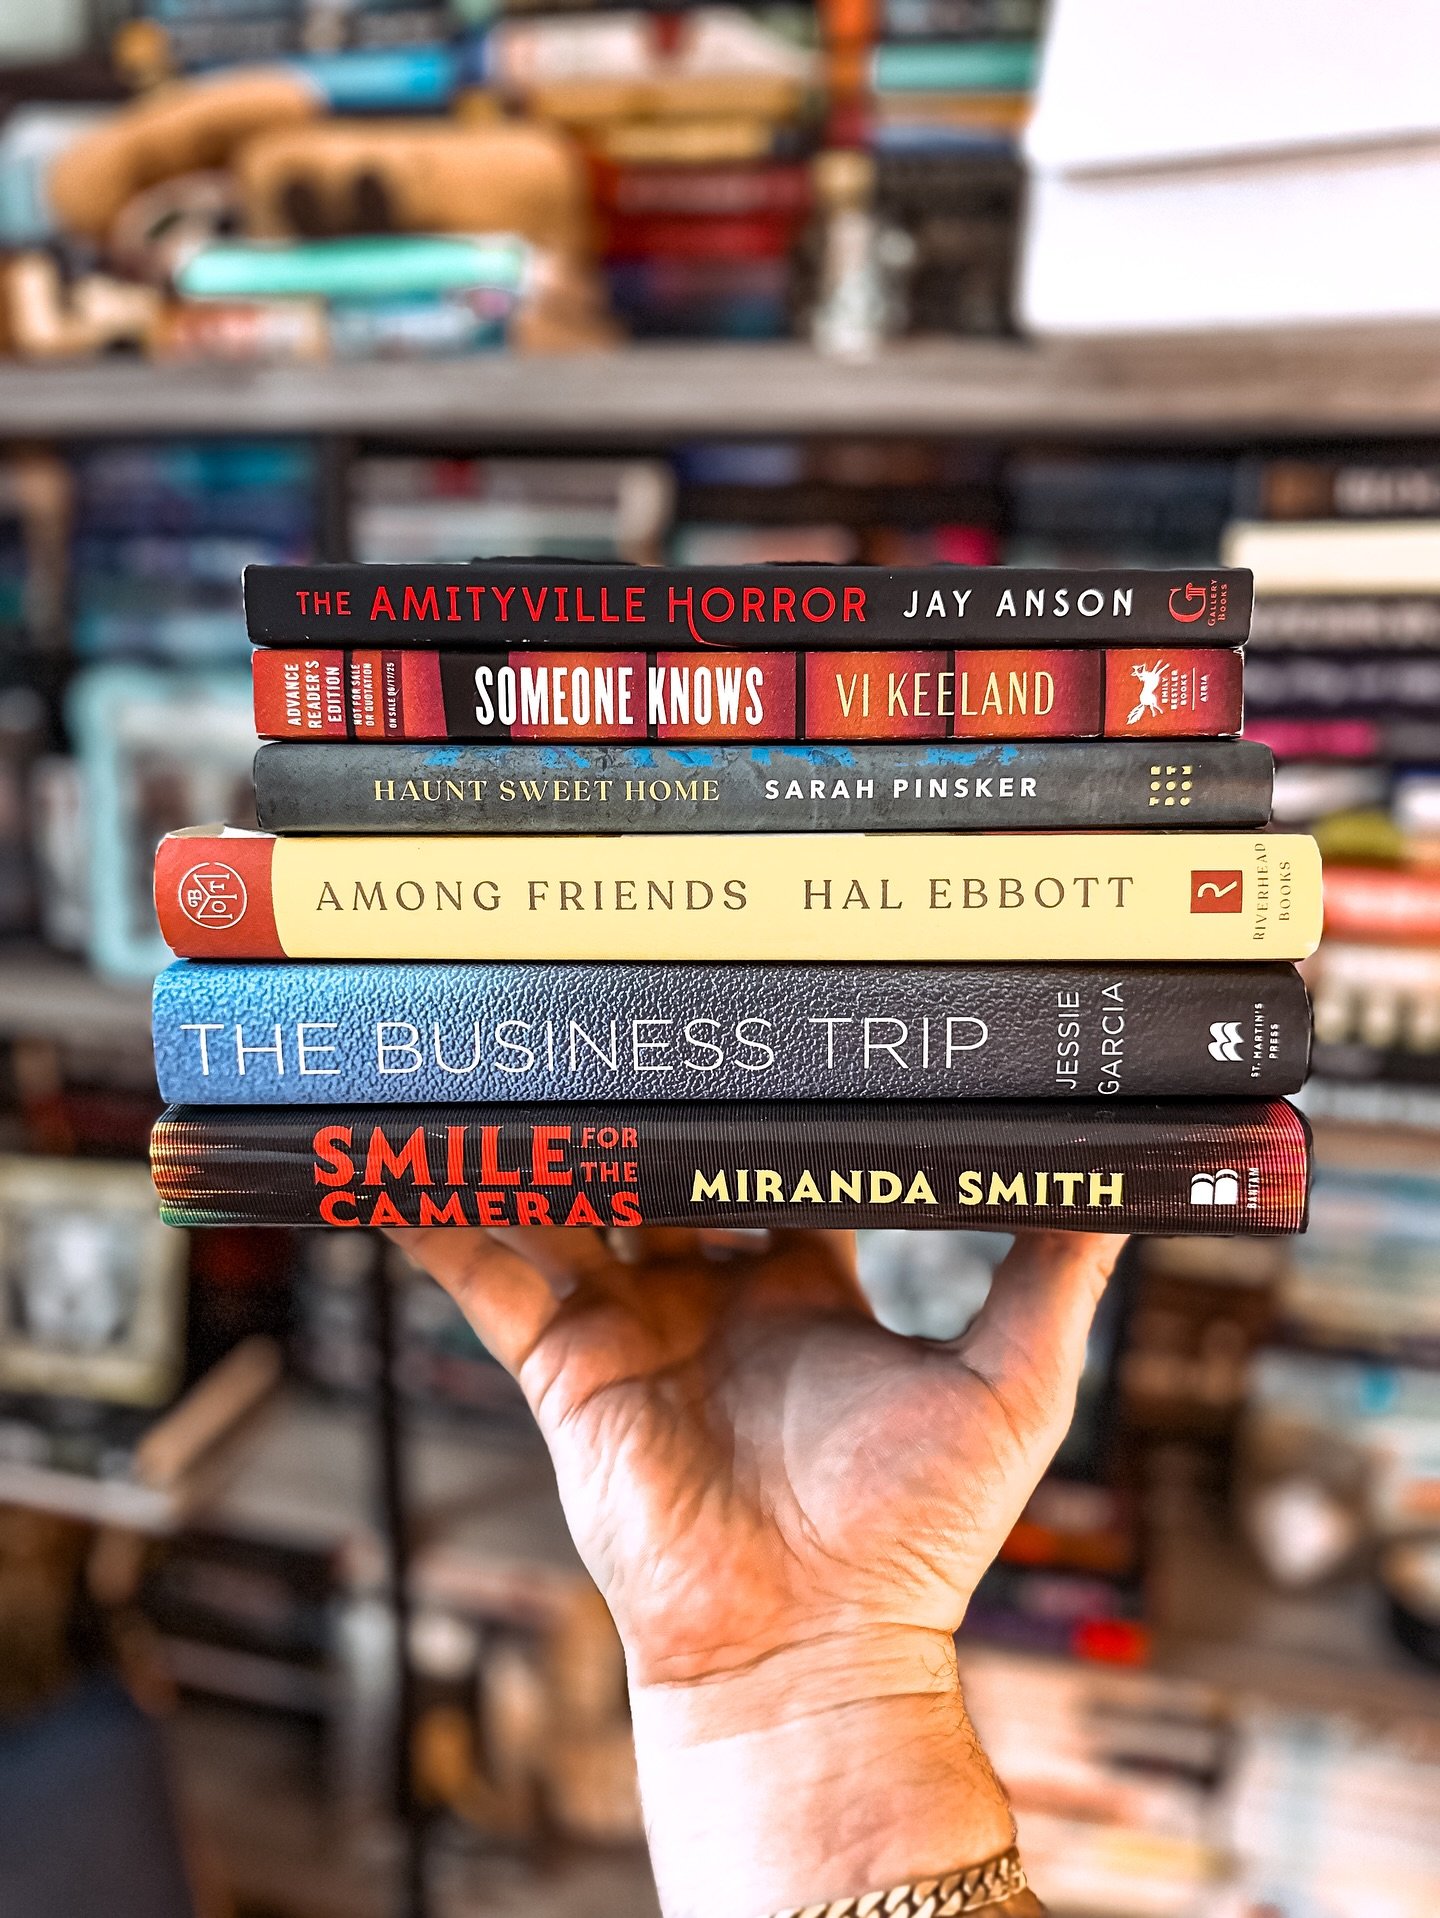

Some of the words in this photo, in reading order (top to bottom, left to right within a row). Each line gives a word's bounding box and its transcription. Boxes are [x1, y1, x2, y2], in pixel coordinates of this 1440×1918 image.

[296, 590, 352, 615] THE
[370, 586, 646, 622] AMITYVILLE
[668, 586, 868, 643] HORROR
[903, 588, 973, 618] JAY
[996, 587, 1135, 618] ANSON
[1207, 579, 1219, 626] GALLERY
[1218, 583, 1228, 621] BOOKS
[350, 664, 361, 687] SALE
[363, 663, 375, 713] QUOTATION
[386, 662, 397, 697] 06/17/25
[835, 674, 870, 717] VI
[889, 671, 1055, 717] KEELAND
[1162, 677, 1170, 703] EMILY
[1171, 669, 1179, 710] BESTLER
[1180, 674, 1188, 706] BOOKS
[1200, 673, 1210, 702] ATRIA
[284, 663, 302, 726] ADVANCE
[305, 660, 323, 729] READER'S
[325, 666, 342, 723] EDITION
[351, 688, 362, 707] FOR
[388, 696, 397, 717] SALE
[474, 665, 634, 725] SOMEONE
[648, 665, 763, 726] KNOWS
[353, 708, 363, 726] NOT
[365, 716, 375, 727] OR
[389, 718, 398, 729] ON
[374, 780, 487, 801] HAUNT
[499, 780, 614, 801] SWEET
[625, 779, 720, 801] HOME
[764, 779, 875, 800] SARAH
[893, 777, 1038, 799] PINSKER
[316, 880, 501, 911] AMONG
[528, 879, 748, 911] FRIENDS
[803, 878, 903, 910] HAL
[928, 876, 1135, 909] EBBOTT
[1253, 843, 1269, 940] RIVERHEAD
[1279, 861, 1291, 921] BOOKS
[180, 1022, 342, 1077] THE
[377, 1017, 775, 1075] BUSINESS
[808, 1017, 989, 1070] TRIP
[1056, 991, 1080, 1090] JESSIE
[1097, 982, 1125, 1095] GARCIA
[1253, 1002, 1265, 1060] MARTIN'S
[1269, 1023, 1280, 1060] PRESS
[1251, 1062, 1261, 1078] ST.
[312, 1125, 573, 1187] SMILE
[581, 1127, 638, 1148] FOR
[580, 1161, 638, 1183] THE
[691, 1169, 937, 1205] MIRANDA
[959, 1170, 1125, 1207] SMITH
[1247, 1167, 1259, 1209] BANTAM
[319, 1191, 643, 1226] CAMERAS
